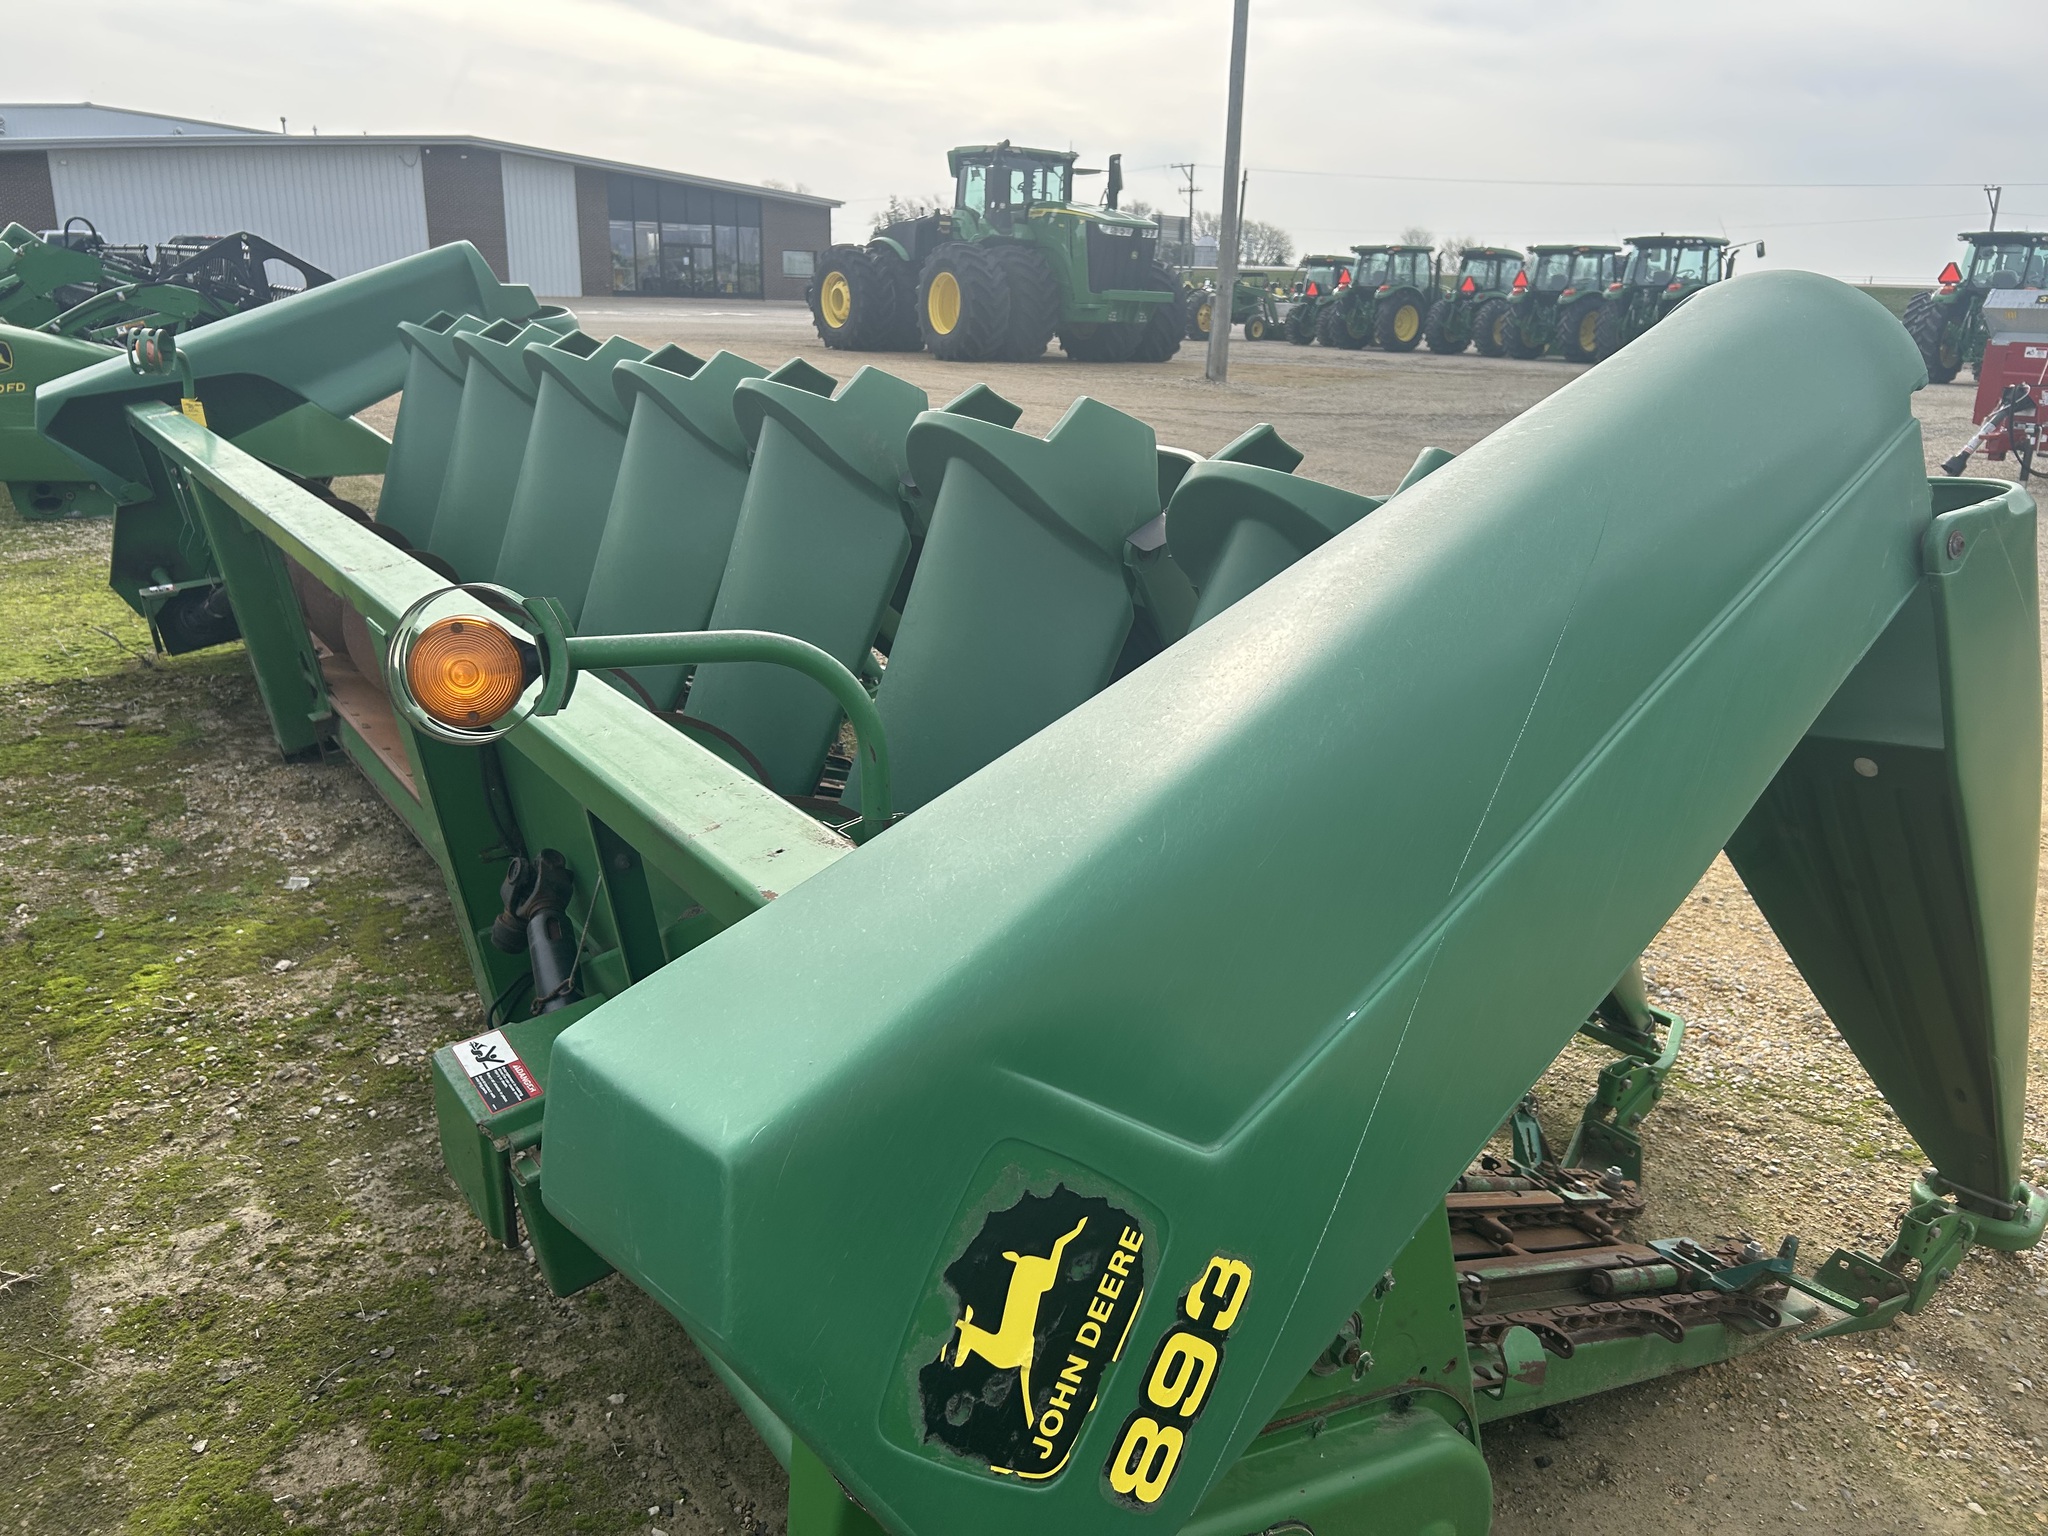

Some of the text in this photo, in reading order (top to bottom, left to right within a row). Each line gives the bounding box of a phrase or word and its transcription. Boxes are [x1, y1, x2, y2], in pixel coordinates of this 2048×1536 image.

[515, 1067, 537, 1093] DANGER
[1032, 1225, 1144, 1460] JOHN DEERE
[1109, 1255, 1253, 1503] 893
